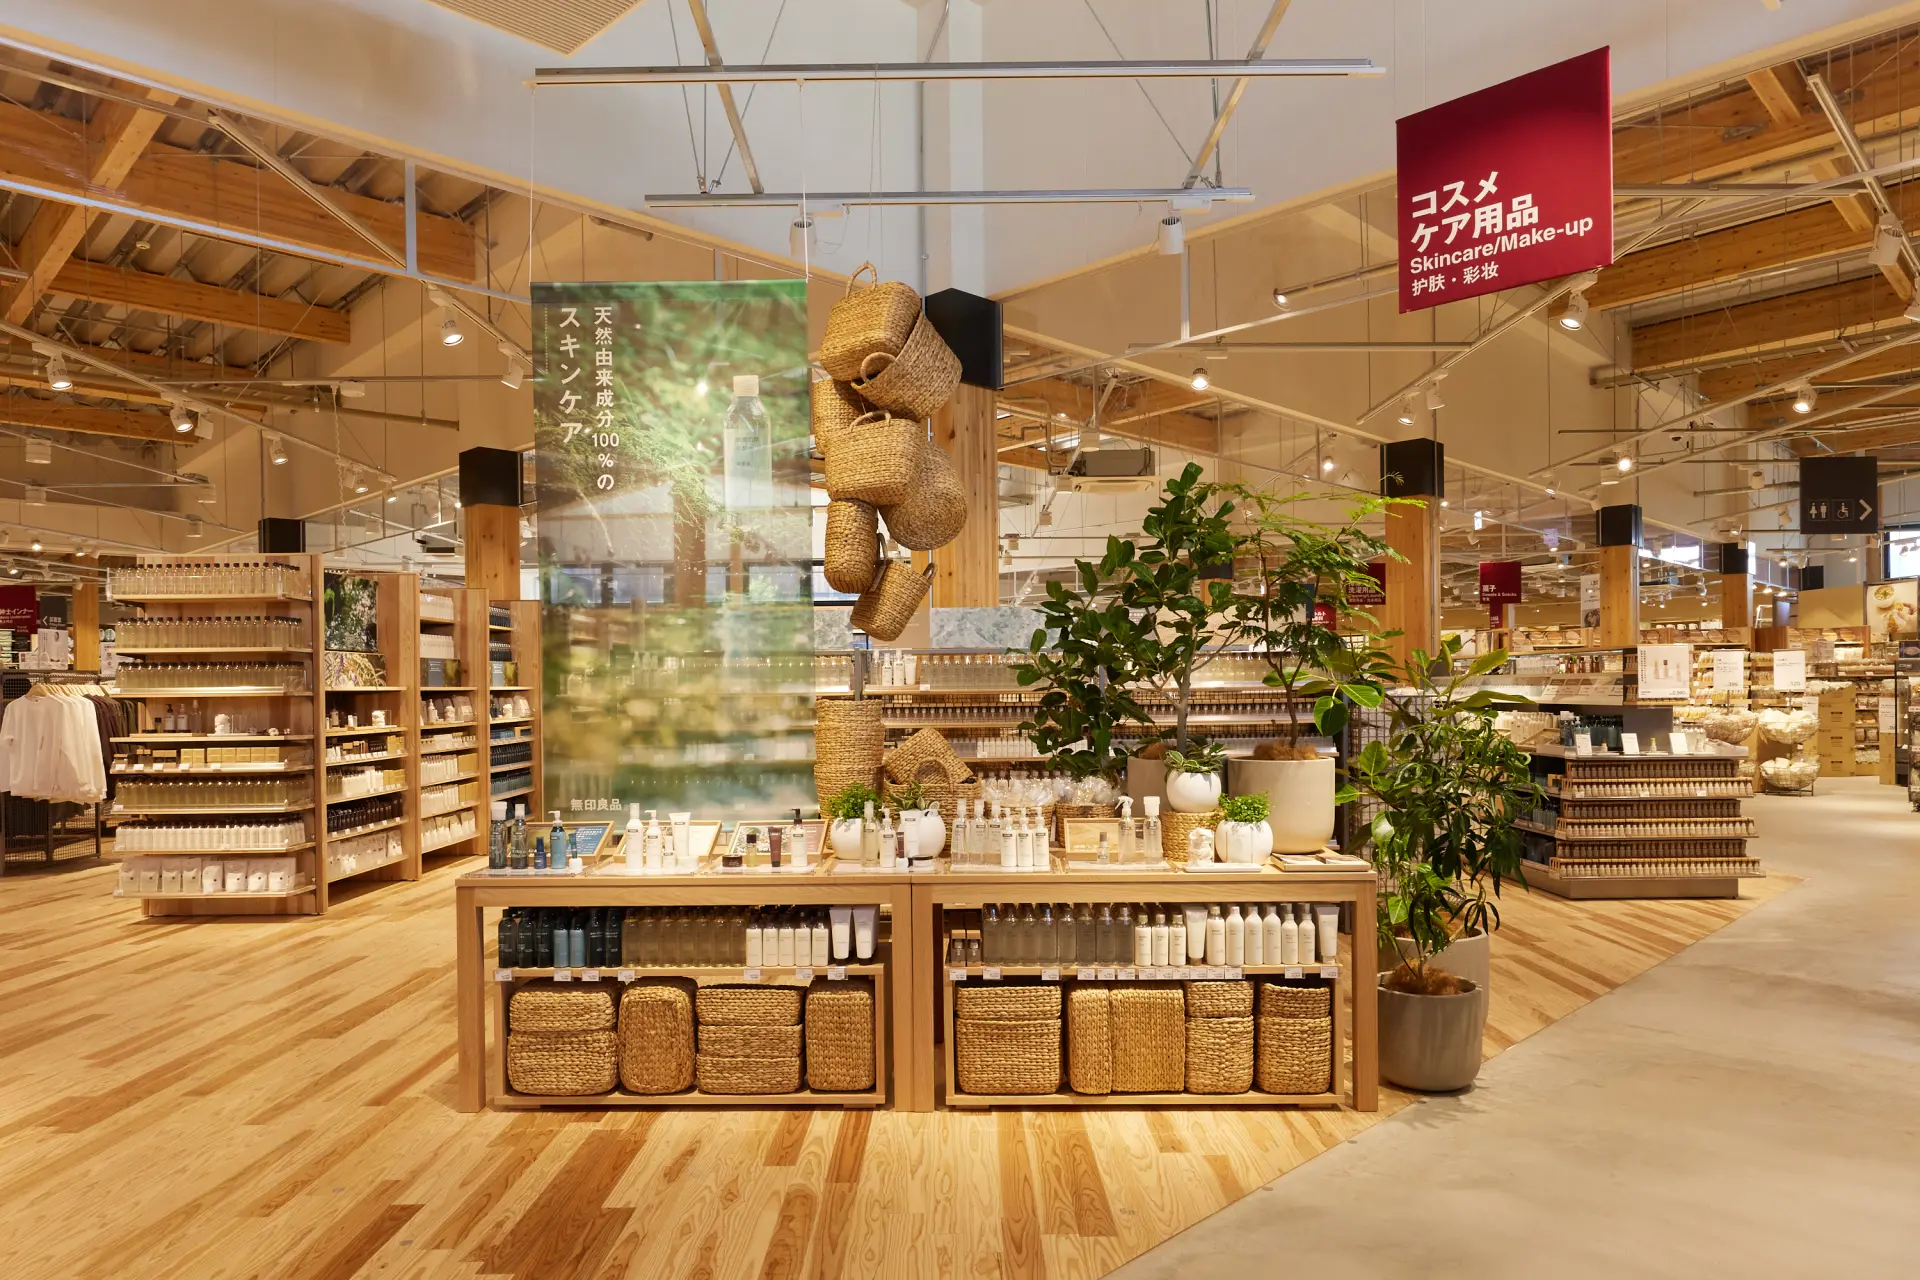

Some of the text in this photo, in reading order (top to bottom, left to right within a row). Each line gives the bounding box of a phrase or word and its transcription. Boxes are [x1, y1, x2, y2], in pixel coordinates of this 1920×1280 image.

[1411, 193, 1539, 253] ケア用品
[1412, 171, 1499, 219] コスメ
[1410, 217, 1594, 275] Skincare/Make-up
[559, 307, 583, 445] スキンケア
[570, 797, 622, 811] 無印良品
